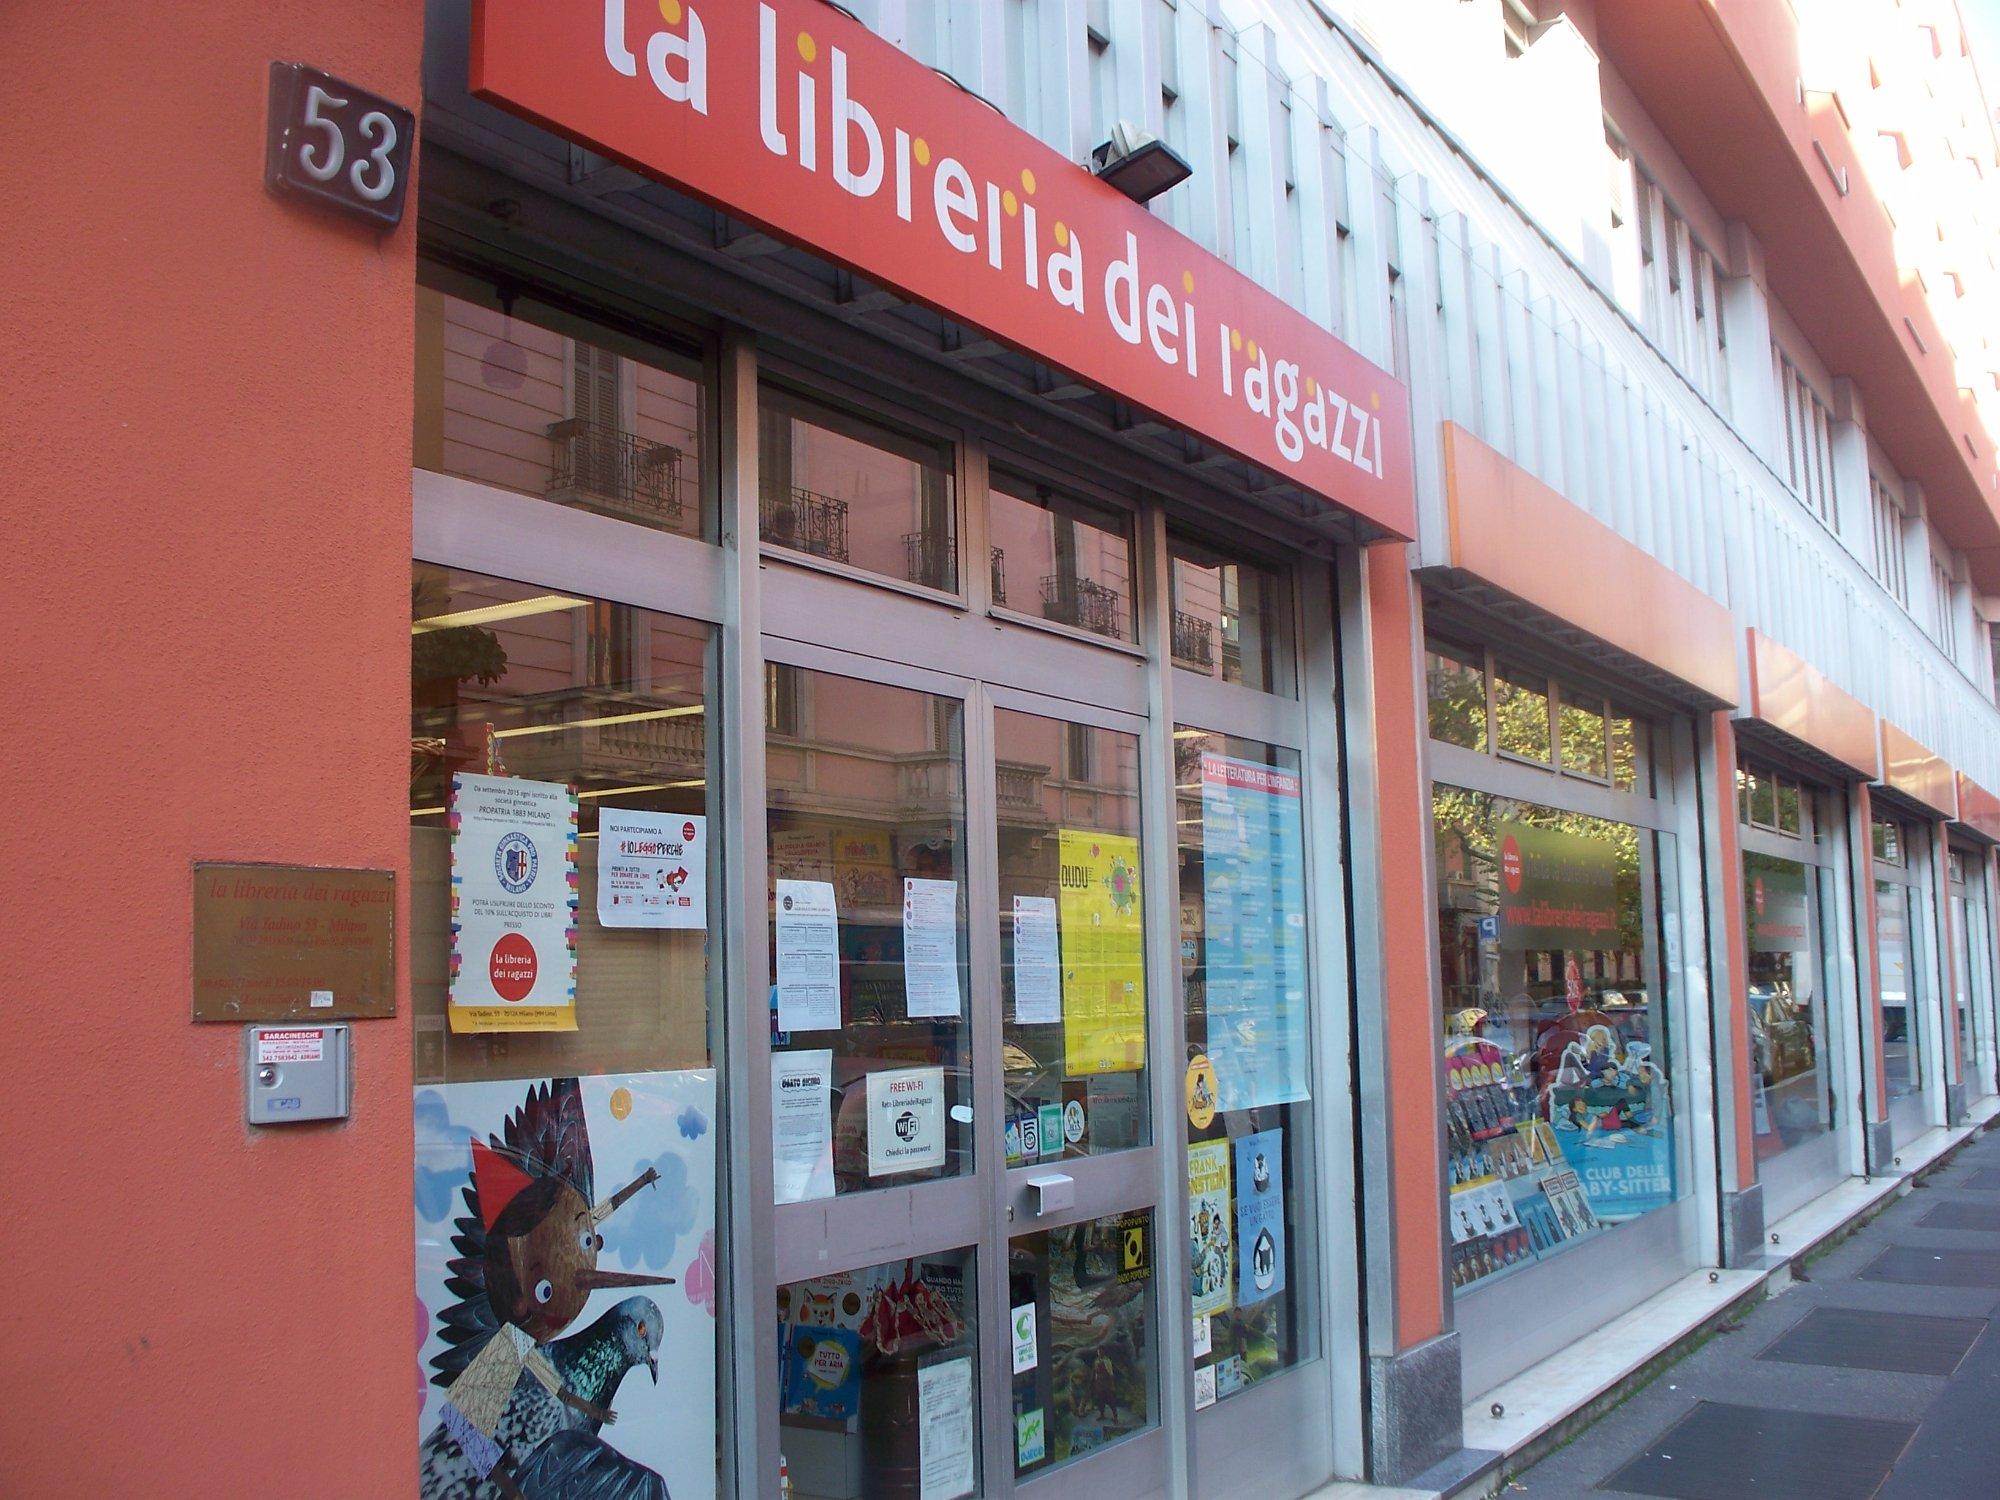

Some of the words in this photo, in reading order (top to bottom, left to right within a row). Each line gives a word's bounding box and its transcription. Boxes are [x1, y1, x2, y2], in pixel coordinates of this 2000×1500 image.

[300, 86, 397, 200] 53
[760, 2, 1085, 316] libreria
[1105, 231, 1198, 378] dei
[1220, 323, 1384, 480] ragazzi
[482, 786, 506, 795] settembre
[479, 805, 511, 816] PROPATRIA
[527, 810, 551, 819] MILANO
[620, 826, 657, 835] PARTECIPIAMO
[1061, 864, 1089, 889] DUDU
[210, 878, 227, 898] la
[233, 879, 299, 901] libreria
[303, 882, 329, 901] dei
[333, 886, 390, 909] ragazzi
[474, 908, 483, 916] DEL
[533, 902, 555, 910] SCONTO
[329, 917, 368, 933] Milano
[495, 953, 503, 964] la
[504, 954, 532, 965] libreria
[493, 968, 506, 978] dei
[507, 969, 534, 980] ragazzi
[263, 1031, 320, 1040] SARACINESCHE
[890, 1081, 906, 1093] FREE
[906, 1080, 924, 1091] WI-FI
[896, 1120, 917, 1134] WiFi
[909, 1144, 931, 1156] password
[1189, 1155, 1217, 1176] FRANK
[1585, 1166, 1622, 1180] CLUB
[1626, 1164, 1664, 1177] DELLE
[1580, 1177, 1671, 1197] ABY-SITTER
[819, 1350, 841, 1361] TUTTO
[814, 1359, 827, 1368] PER
[828, 1359, 844, 1369] ARIA
